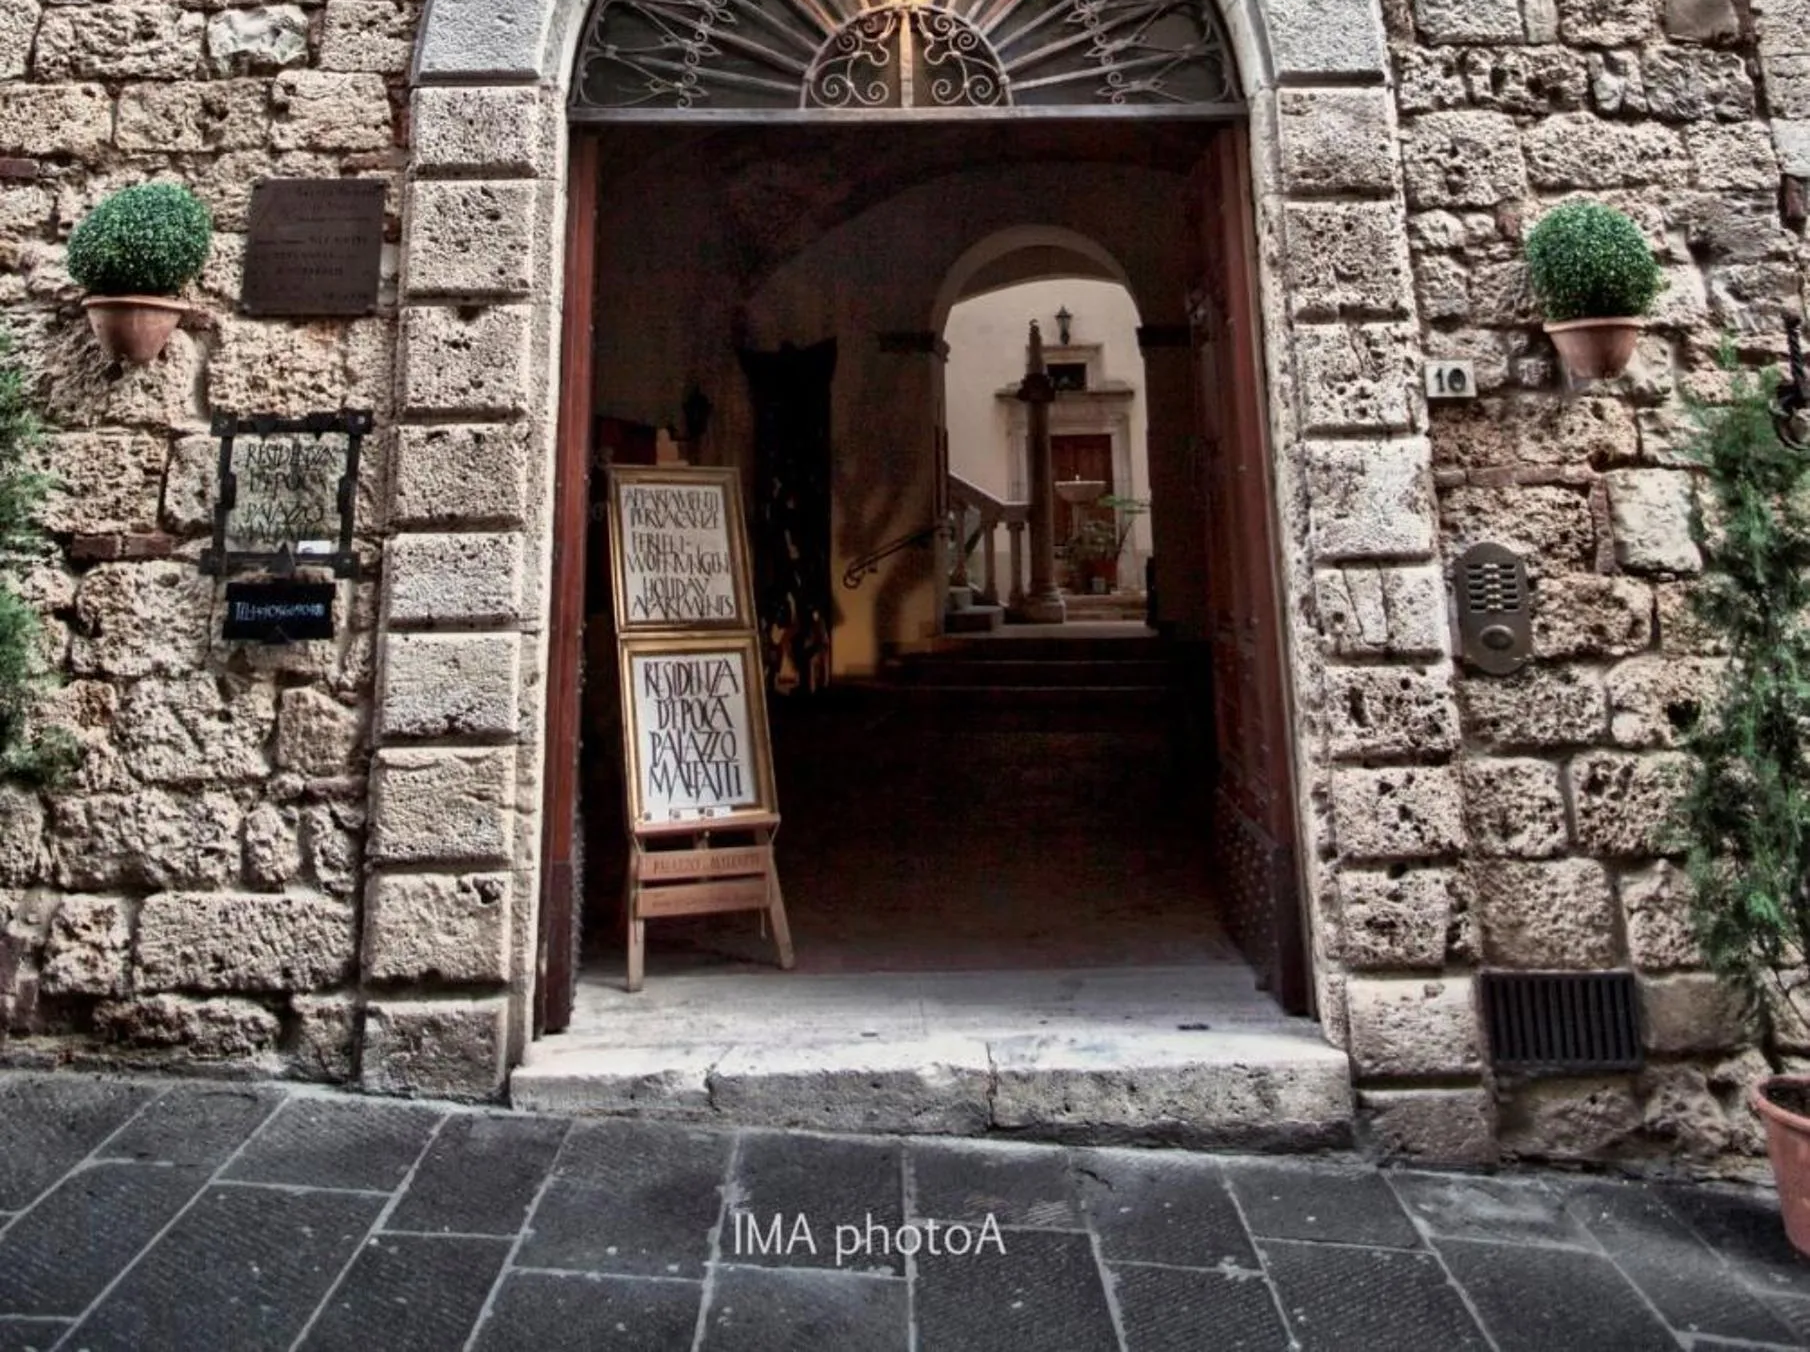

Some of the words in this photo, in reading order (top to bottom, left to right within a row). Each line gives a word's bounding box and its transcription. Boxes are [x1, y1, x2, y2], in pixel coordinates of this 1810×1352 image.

[1434, 367, 1467, 393] 10
[643, 576, 710, 599] HOLIDAY
[643, 659, 740, 698] RESIDENZA
[650, 730, 739, 766] PALAZZO
[650, 760, 742, 802] MALFATTI
